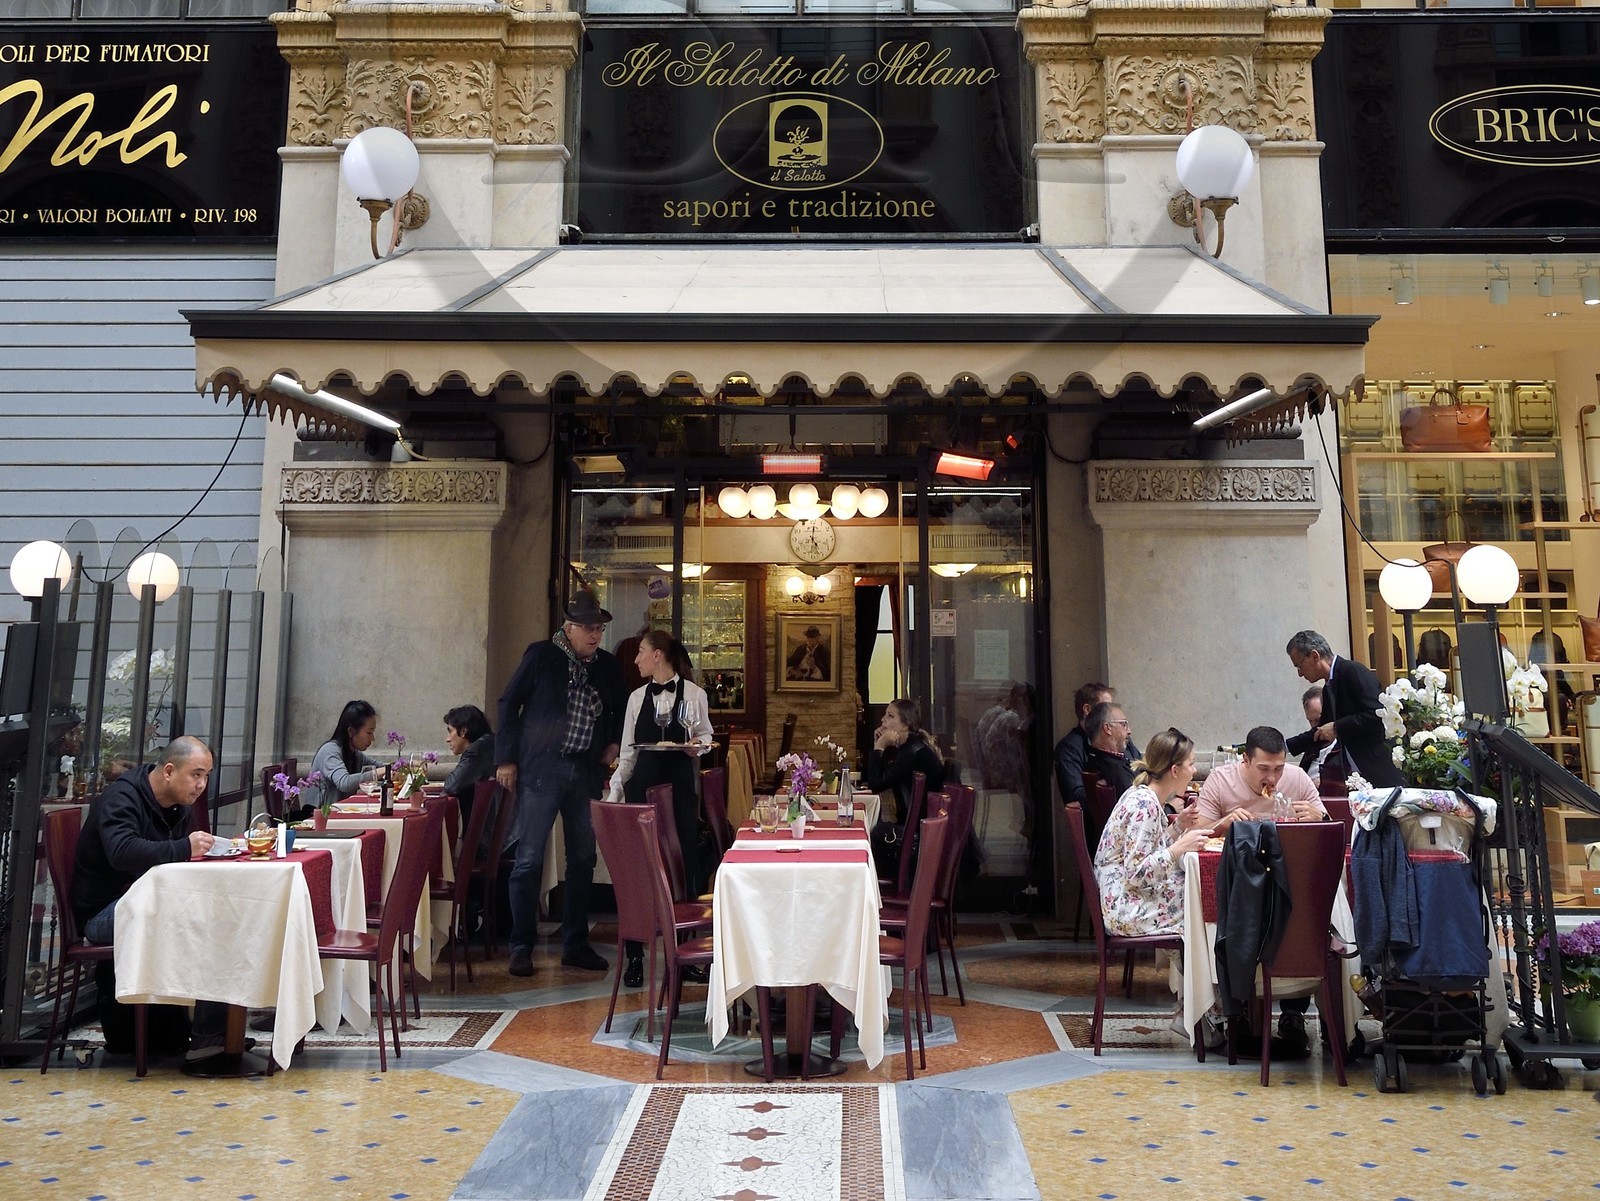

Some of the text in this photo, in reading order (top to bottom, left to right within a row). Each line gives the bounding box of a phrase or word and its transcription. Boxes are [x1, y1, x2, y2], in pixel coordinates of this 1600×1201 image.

[44, 44, 90, 63] PER
[99, 43, 210, 63] FUMATORI
[602, 41, 1001, 87] Il Salotto di Milano
[1472, 106, 1600, 143] BRIC'S
[770, 169, 826, 181] il Salotto
[37, 208, 98, 223] VALORI
[105, 208, 172, 223] BOLLATI
[194, 208, 227, 223] RIV.
[233, 208, 257, 223] 198
[663, 190, 935, 226] sapori e tradizione
